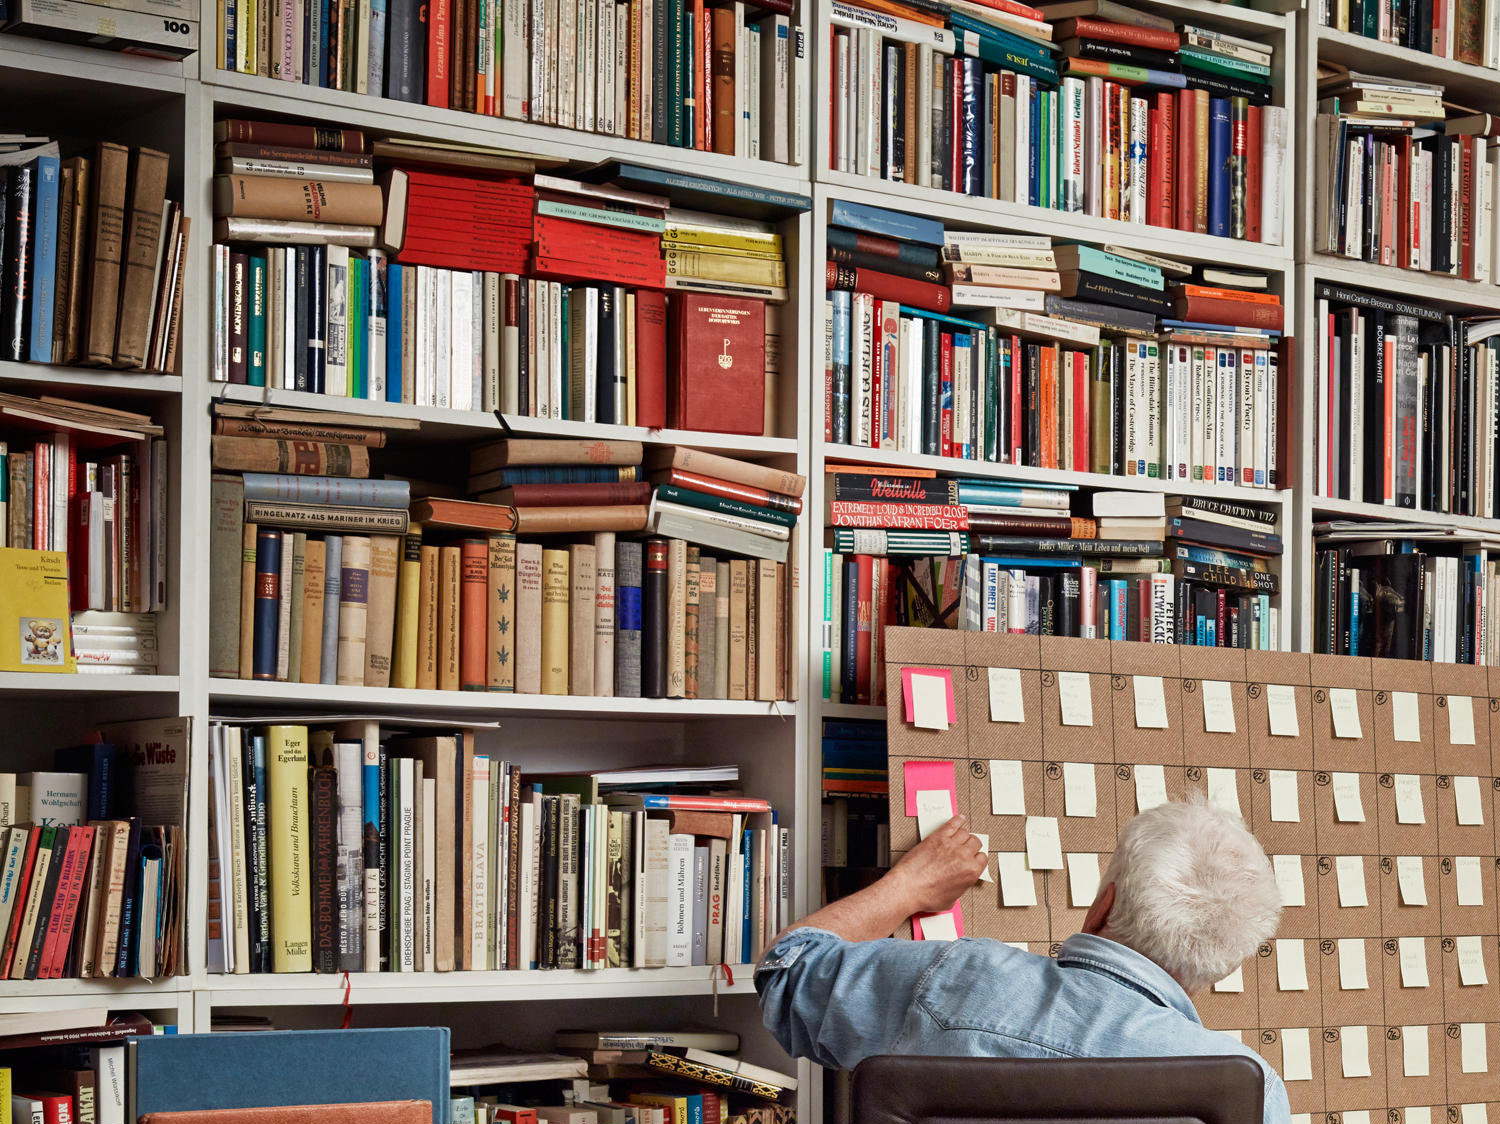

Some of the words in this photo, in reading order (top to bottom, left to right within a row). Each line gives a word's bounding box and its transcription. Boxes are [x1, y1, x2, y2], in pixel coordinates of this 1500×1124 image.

[164, 20, 190, 34] 100
[436, 24, 444, 45] Lima
[436, 47, 444, 79] Lezama
[1006, 54, 1029, 66] JESUS
[1073, 88, 1081, 118] Gebürtig
[1337, 291, 1350, 300] Henri
[1351, 294, 1393, 309] Cartier-Bresson
[1396, 304, 1442, 319] SOWJETUNION
[1244, 369, 1252, 402] Byron's
[1129, 397, 1135, 405] of
[1206, 376, 1214, 440] Confidence-Man
[1243, 402, 1252, 431] Poetry
[871, 477, 927, 500] Wellville
[948, 480, 958, 505] BOYLE
[255, 510, 305, 519] RINGELNATZ
[327, 515, 364, 523] MARINER
[833, 502, 875, 513] EXTREMELY
[877, 504, 898, 515] LOUD
[899, 505, 904, 513] &
[906, 505, 942, 516] INCREDIBLY
[943, 506, 966, 518] CLOSE
[1193, 498, 1218, 513] BRUCE
[1219, 503, 1255, 519] CHATWIN
[1259, 510, 1275, 523] UTZ
[834, 514, 882, 527] JONATHAN
[884, 516, 922, 528] SAFRAN
[924, 518, 958, 529] FOER
[1039, 542, 1056, 551] Henry
[1058, 543, 1074, 551] Miller
[1079, 543, 1092, 552] Mein
[1094, 543, 1110, 553] Leben
[1111, 544, 1120, 553] und
[1123, 544, 1137, 553] meine
[1138, 544, 1149, 553] Welt
[988, 568, 996, 583] LILY
[1208, 565, 1229, 574] LEE
[1254, 573, 1270, 581] ONE
[1203, 572, 1236, 585] CHILD
[1253, 580, 1274, 590] SHOT
[988, 585, 996, 610] BRETT
[285, 739, 301, 748] Eger
[278, 754, 306, 763] Egerland
[46, 790, 78, 798] Hermann
[292, 852, 301, 896] Volkskunst
[677, 858, 685, 886] Mähren
[476, 842, 484, 941] BRATISLAVA
[677, 888, 685, 902] und
[405, 900, 413, 919] PRAG
[712, 894, 720, 924] PRAG
[677, 904, 685, 934] Böhmen
[285, 940, 308, 950] Langen
[286, 946, 307, 956] Müller
[405, 921, 413, 966] DREHSCHEIBE
